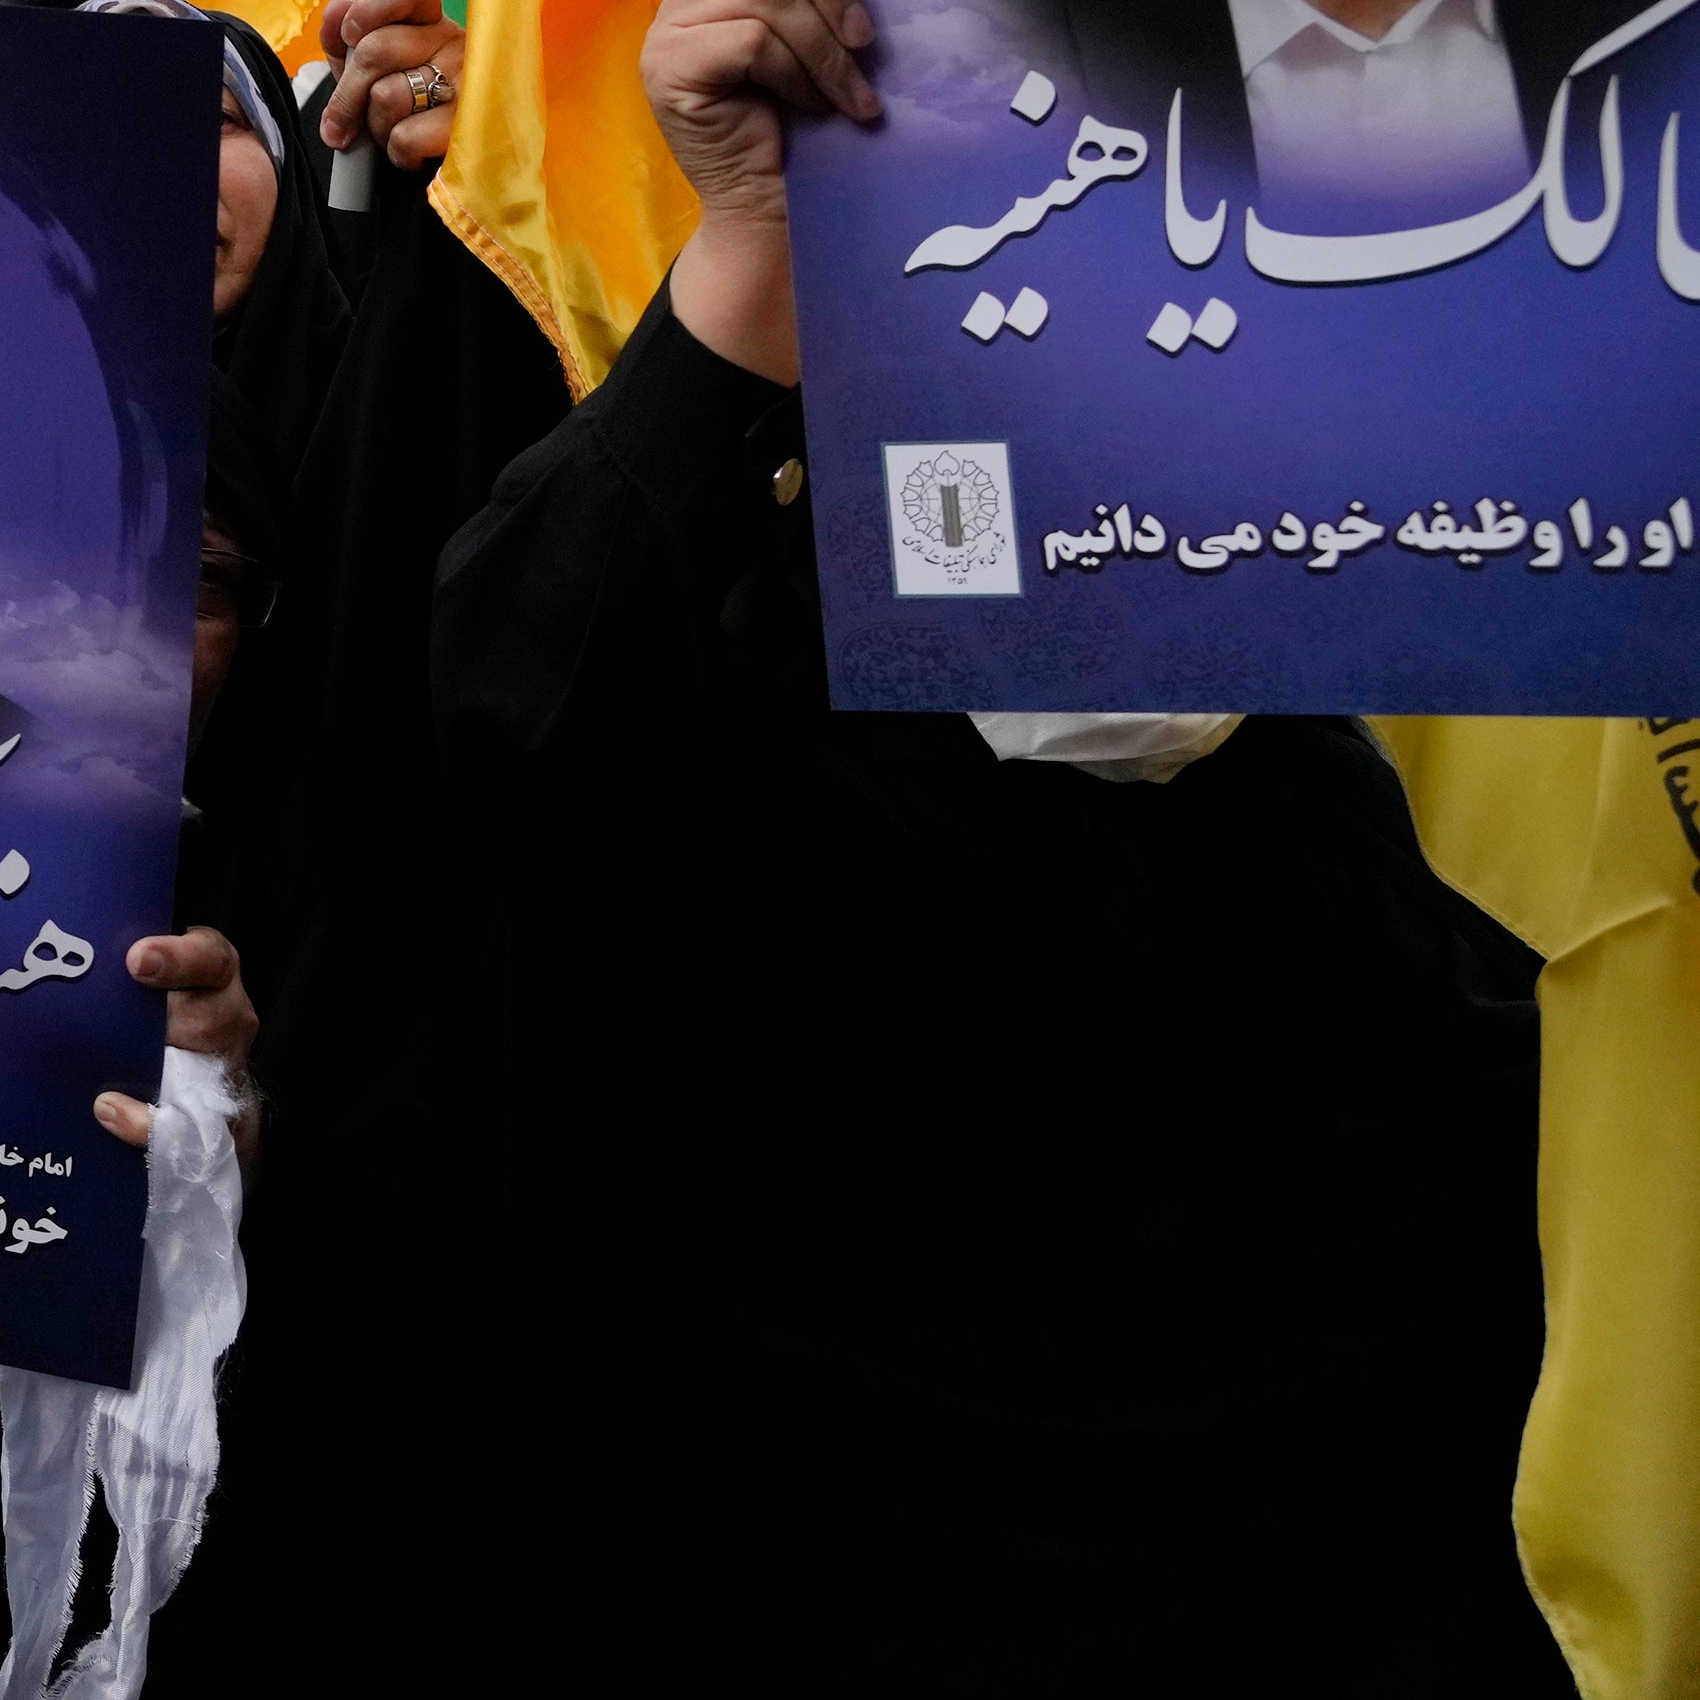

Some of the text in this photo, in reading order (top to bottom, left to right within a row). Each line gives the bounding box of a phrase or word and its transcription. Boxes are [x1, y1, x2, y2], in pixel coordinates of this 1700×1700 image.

[1146, 87, 1238, 353] یا
[1043, 497, 1694, 570] او را وظیفه خود می دانیم
[29, 1153, 73, 1177] امام
